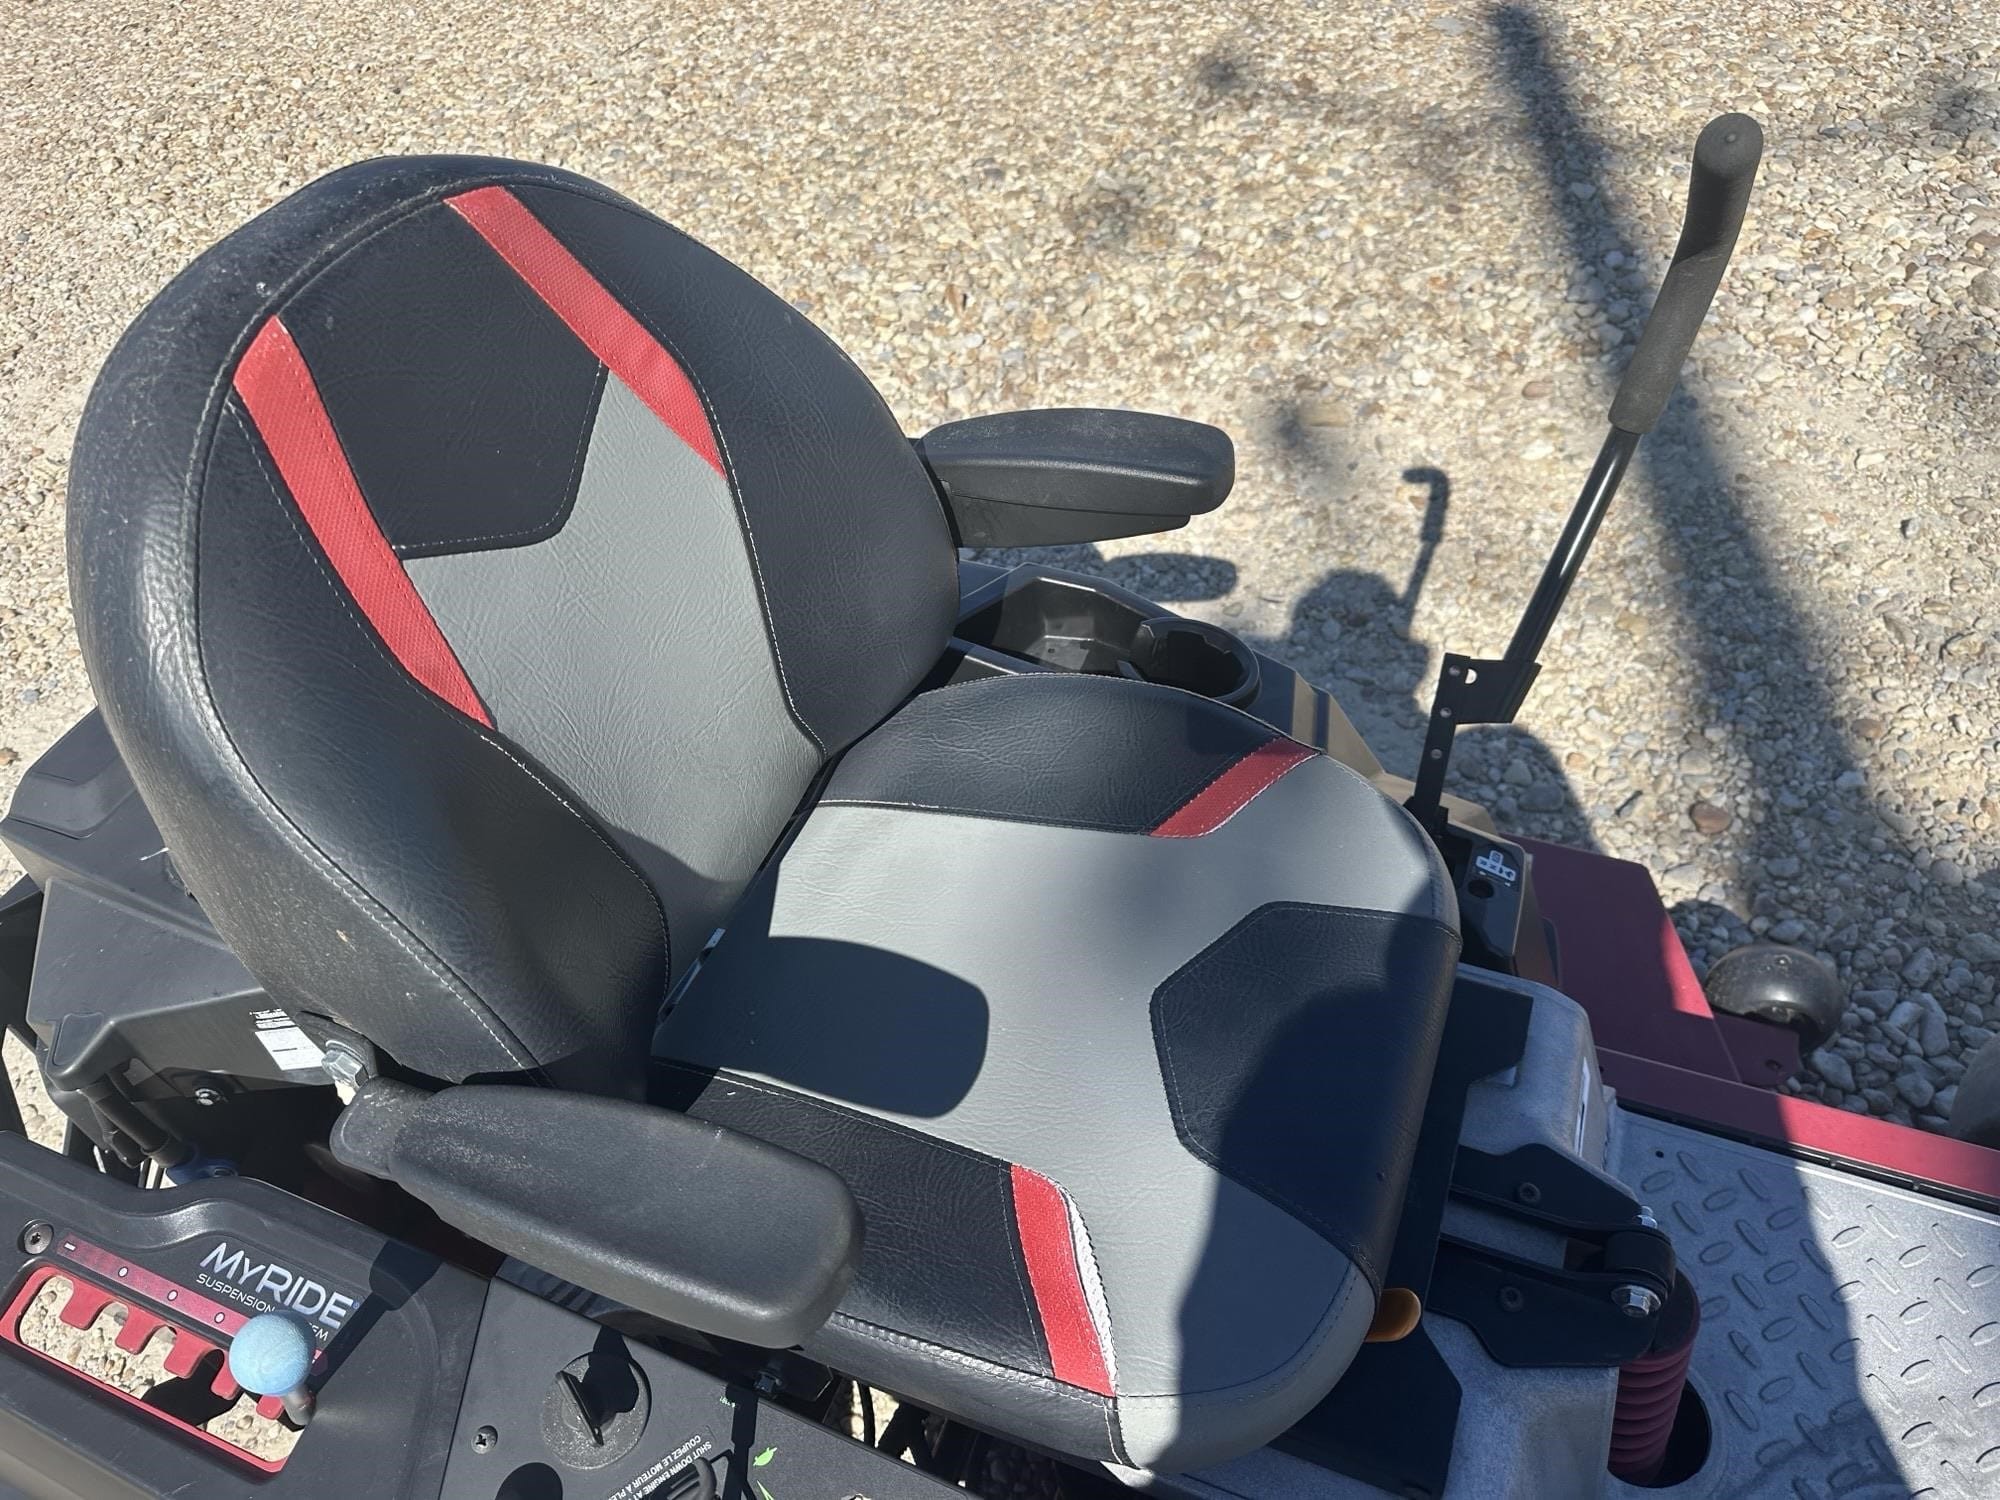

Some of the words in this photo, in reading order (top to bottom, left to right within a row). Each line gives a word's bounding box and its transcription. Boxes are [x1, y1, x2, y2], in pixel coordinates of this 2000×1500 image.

[196, 1273, 275, 1313] SUSPENSION
[671, 1435, 701, 1460] COUPEZ
[694, 1441, 712, 1459] SHUT
[662, 1455, 674, 1467] LE
[669, 1455, 693, 1476] DOWN
[632, 1462, 663, 1488] MOTEUR
[642, 1471, 671, 1495] ENGINE
